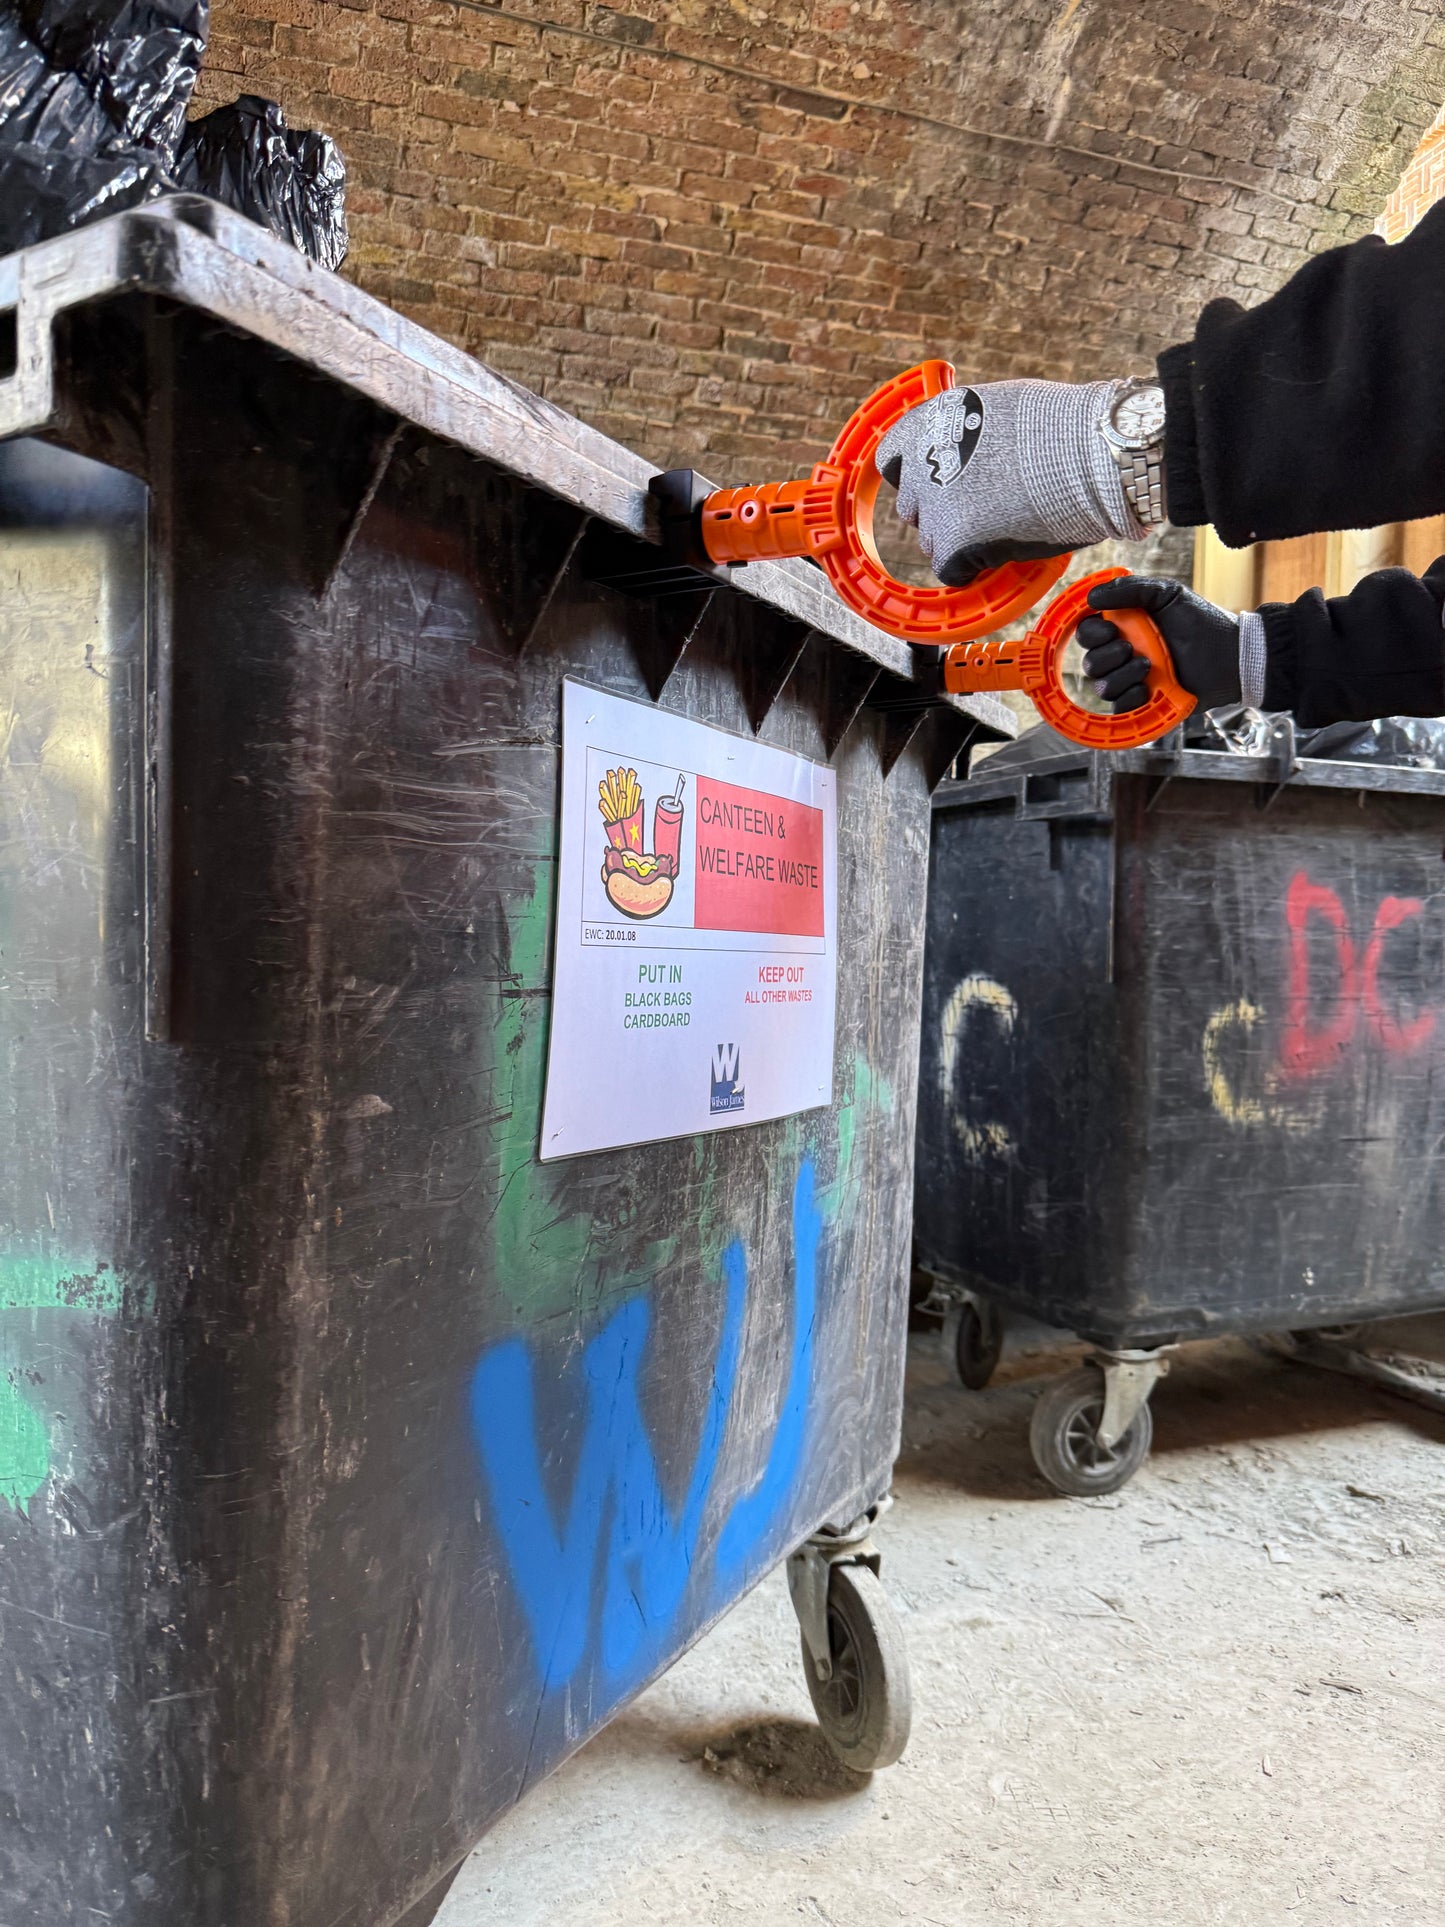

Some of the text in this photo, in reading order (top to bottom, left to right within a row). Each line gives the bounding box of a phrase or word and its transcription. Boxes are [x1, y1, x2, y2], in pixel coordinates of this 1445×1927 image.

[700, 797, 786, 839] CANTEEN &
[699, 845, 818, 888] WELFARE WASTE
[584, 928, 637, 941] EWC: 20.01.08
[638, 964, 682, 983] PUT IN
[758, 966, 805, 983] KEEP OUT
[624, 991, 692, 1007] BLACK BAGS
[744, 989, 813, 1004] ALL OTHER WASTES
[623, 1012, 691, 1029] CARDBOARD
